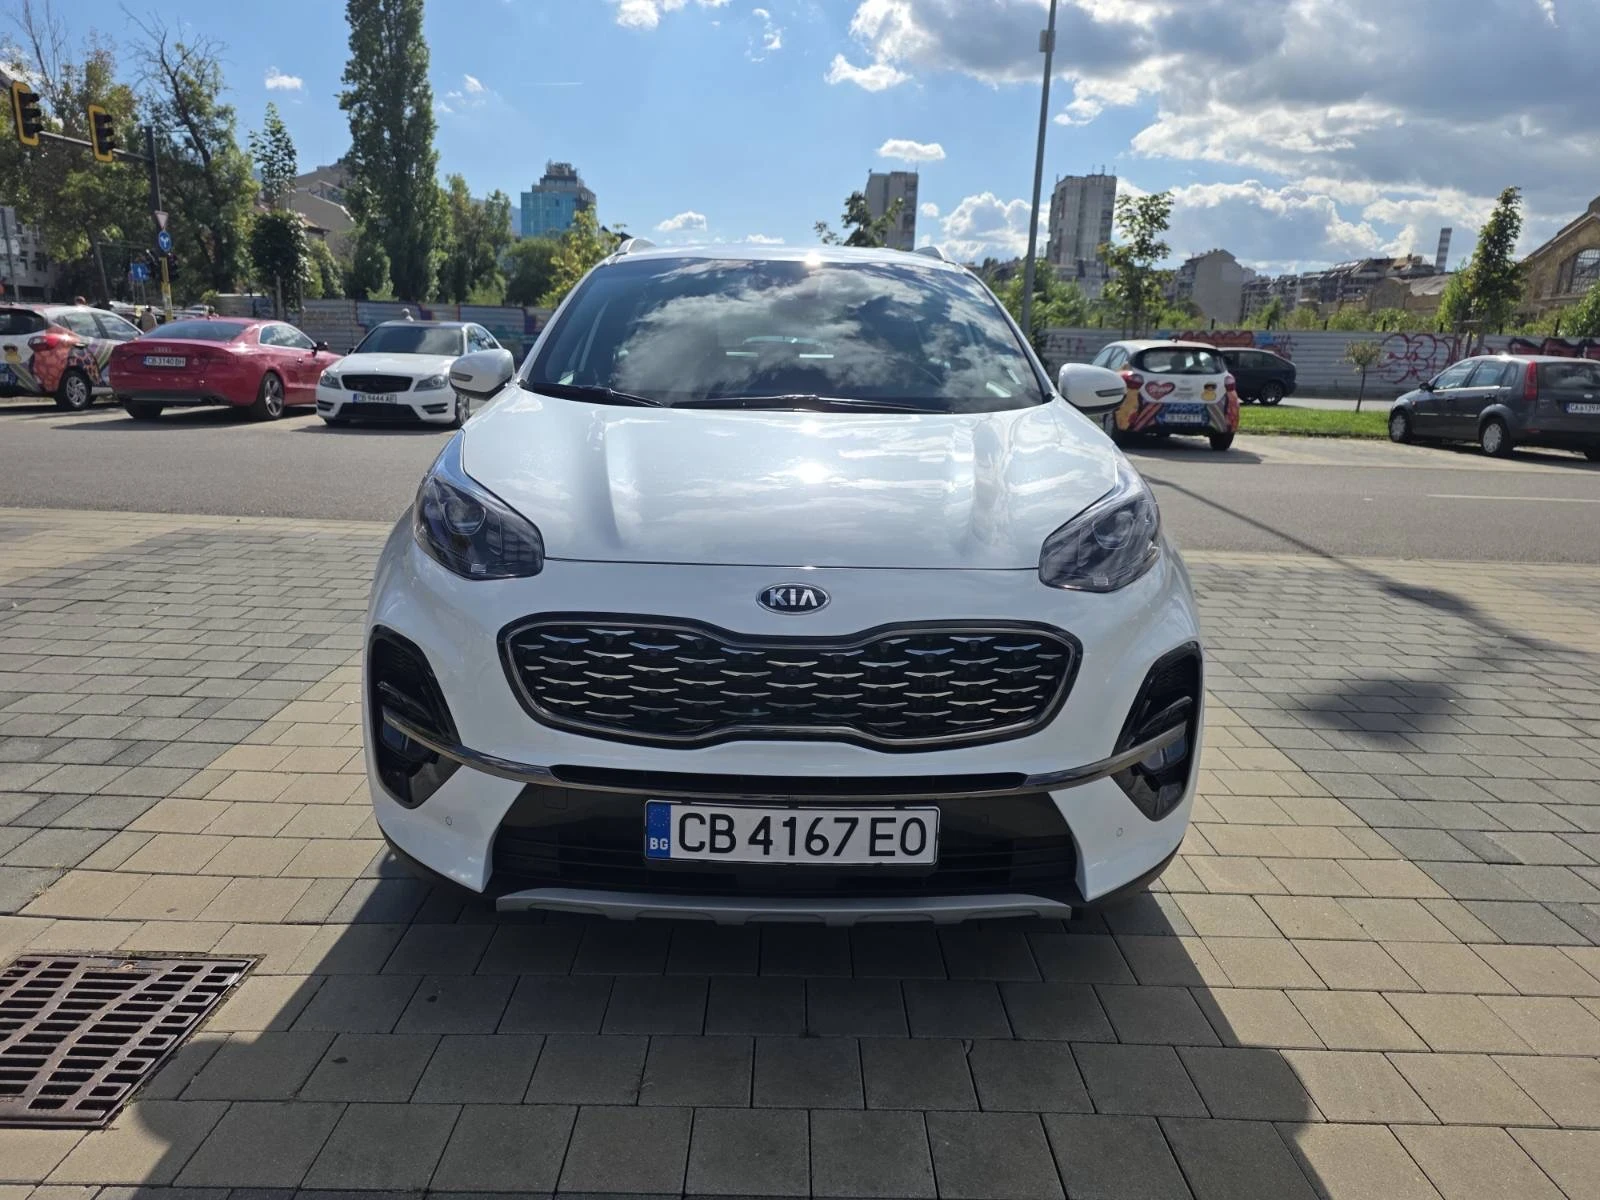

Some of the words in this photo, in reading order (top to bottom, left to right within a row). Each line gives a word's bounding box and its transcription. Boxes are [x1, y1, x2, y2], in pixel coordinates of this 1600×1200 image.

[769, 589, 818, 607] KIA
[649, 837, 669, 850] BG
[678, 812, 737, 854] CB
[747, 815, 860, 857] 4167
